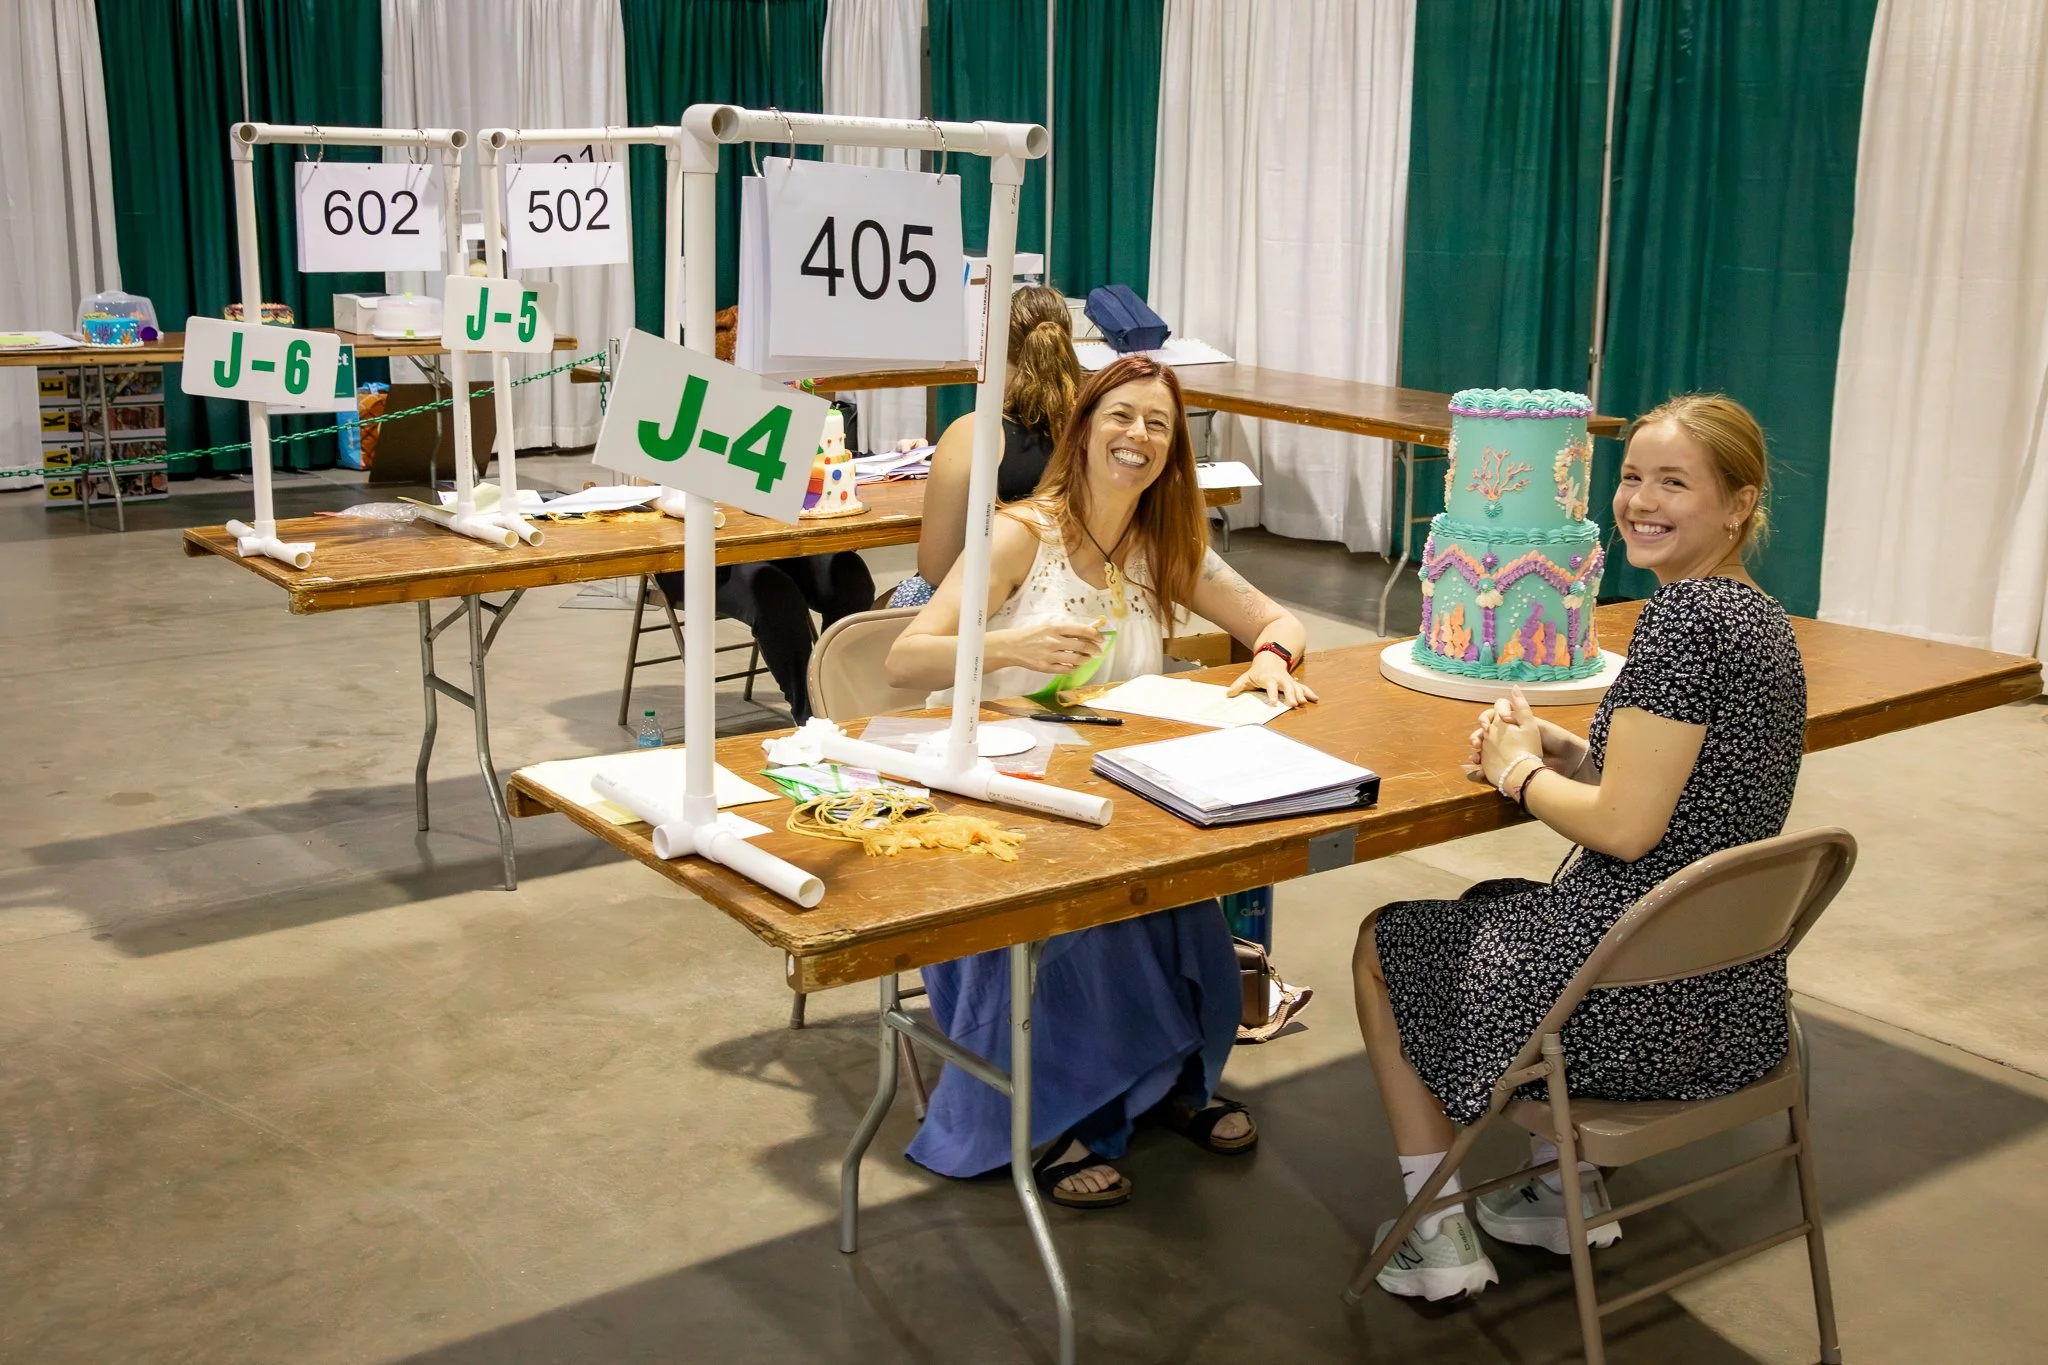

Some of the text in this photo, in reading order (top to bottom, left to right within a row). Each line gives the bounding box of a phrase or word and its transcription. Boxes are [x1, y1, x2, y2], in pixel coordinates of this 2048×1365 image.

[324, 190, 420, 236] 602
[528, 188, 610, 234] 502
[800, 216, 938, 303] 405
[466, 287, 538, 343] J-5
[213, 332, 311, 395] J-6
[637, 374, 792, 493] J-4
